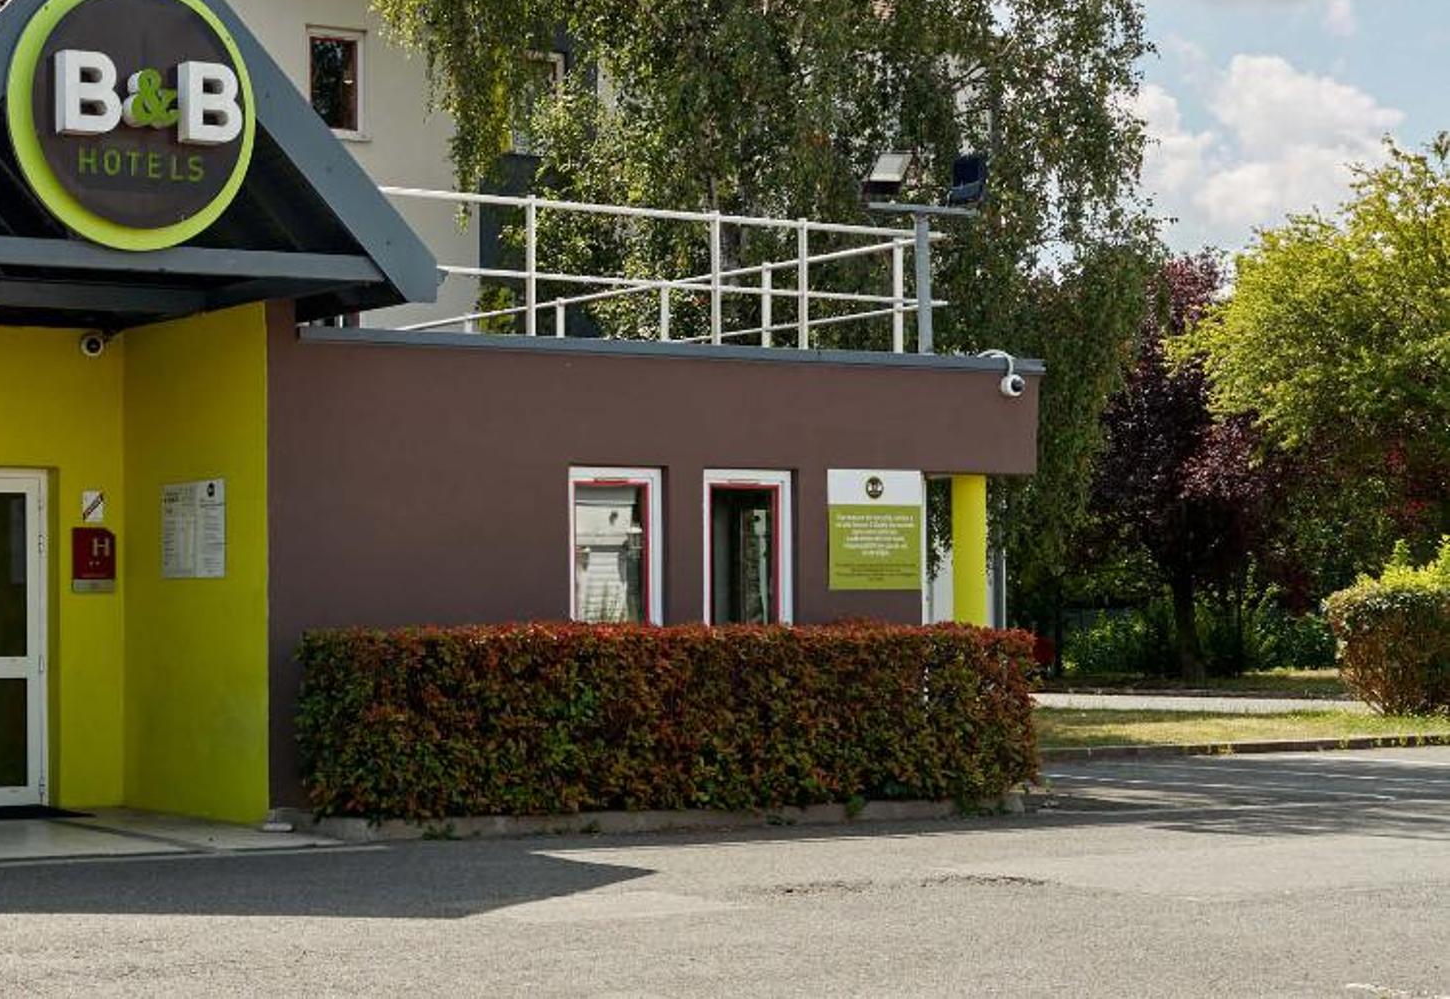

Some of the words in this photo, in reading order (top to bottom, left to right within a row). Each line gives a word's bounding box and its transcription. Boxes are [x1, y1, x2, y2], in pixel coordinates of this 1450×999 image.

[55, 50, 243, 144] B&B
[78, 145, 205, 182] HOTELS
[92, 537, 110, 557] H
